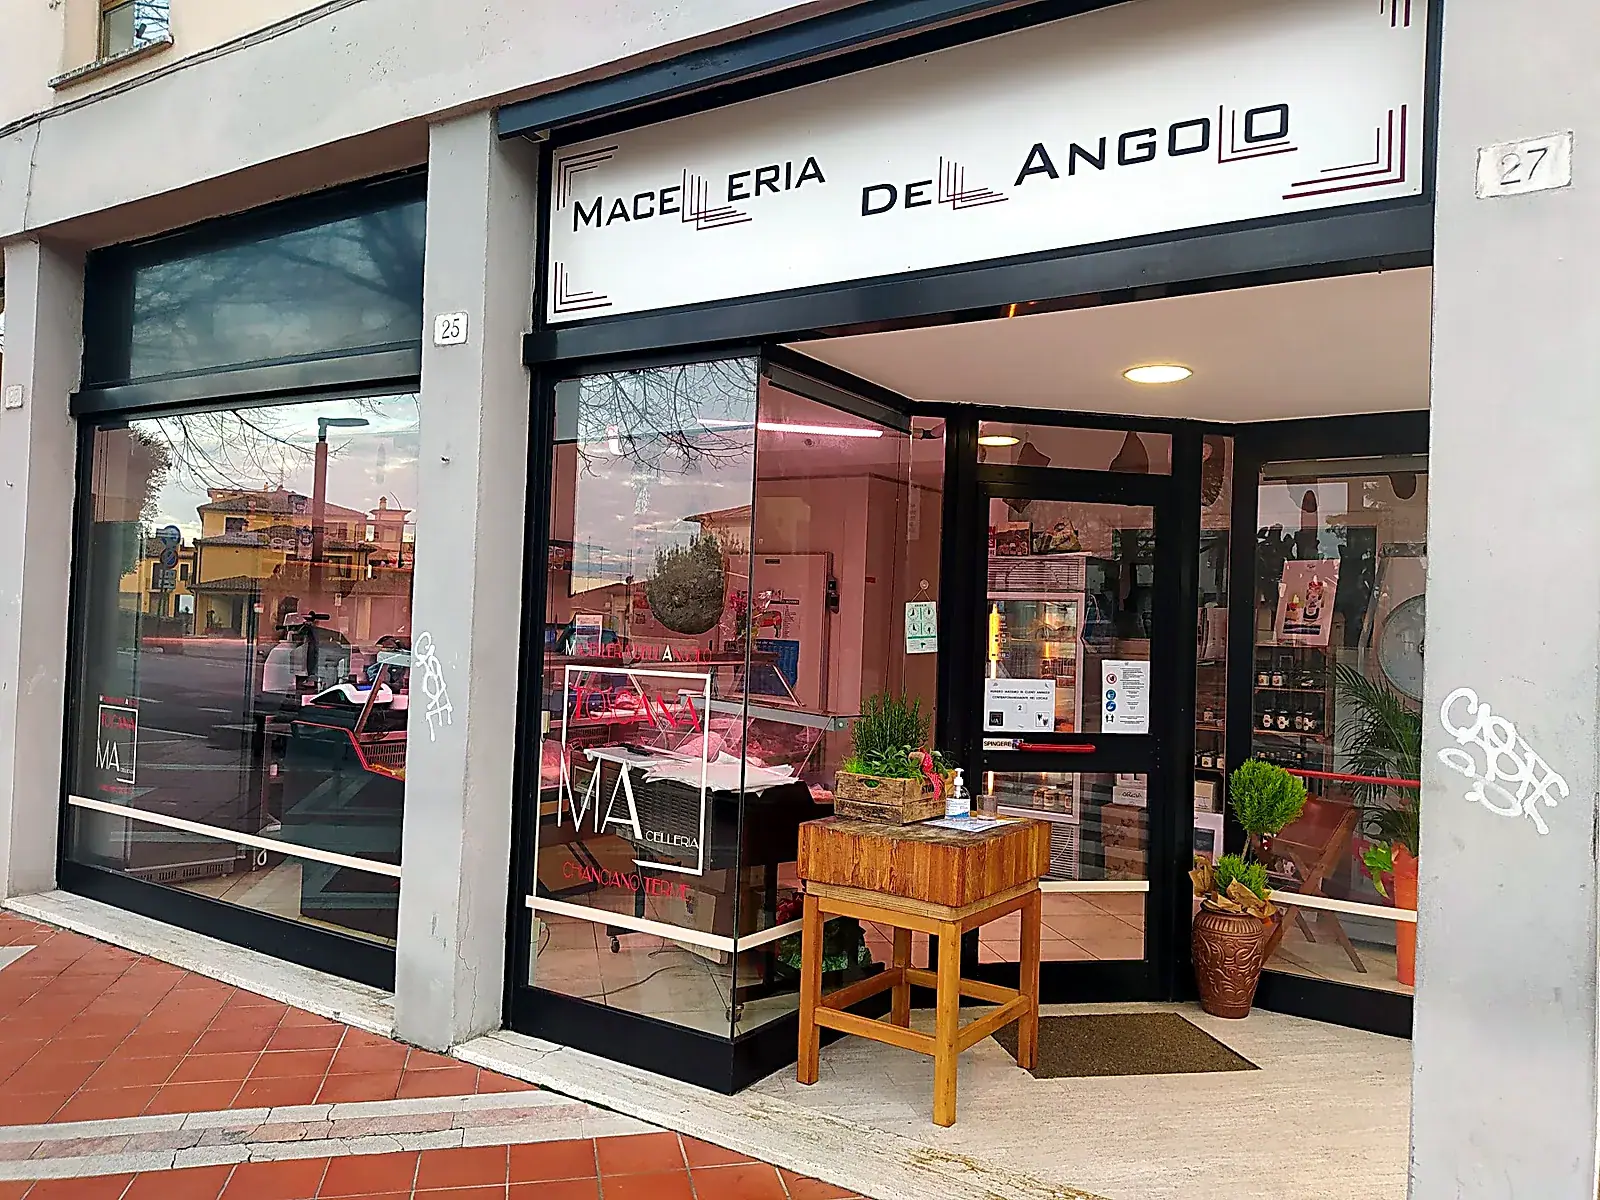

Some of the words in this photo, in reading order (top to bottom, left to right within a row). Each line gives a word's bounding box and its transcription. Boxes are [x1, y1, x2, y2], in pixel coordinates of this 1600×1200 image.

[572, 156, 826, 232] MACELLERIA
[1013, 103, 1298, 187] ANGOLO
[1499, 145, 1549, 186] 27
[441, 317, 460, 340] 25
[643, 876, 692, 902] TERME
